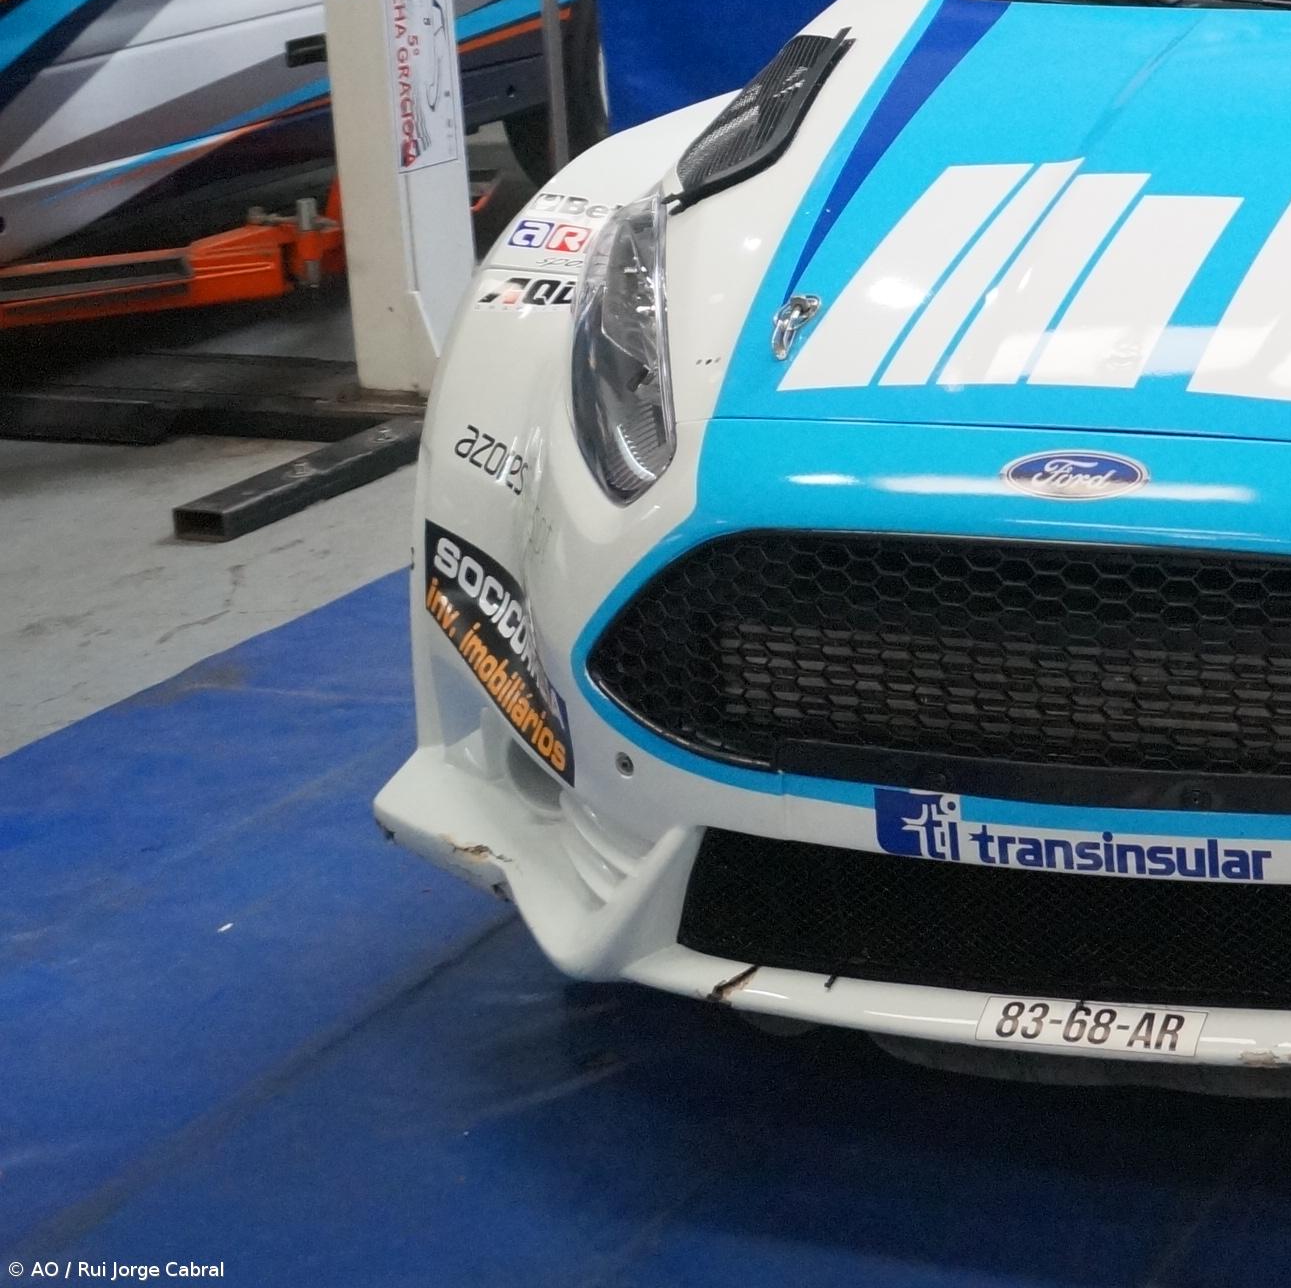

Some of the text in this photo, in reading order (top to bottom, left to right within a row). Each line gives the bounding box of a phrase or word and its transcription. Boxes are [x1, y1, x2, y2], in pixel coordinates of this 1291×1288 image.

[1031, 458, 1117, 489] Ford
[459, 621, 567, 772] imobiliários
[968, 824, 1273, 881] transinsular
[995, 1001, 1186, 1052] 83-68-AR
